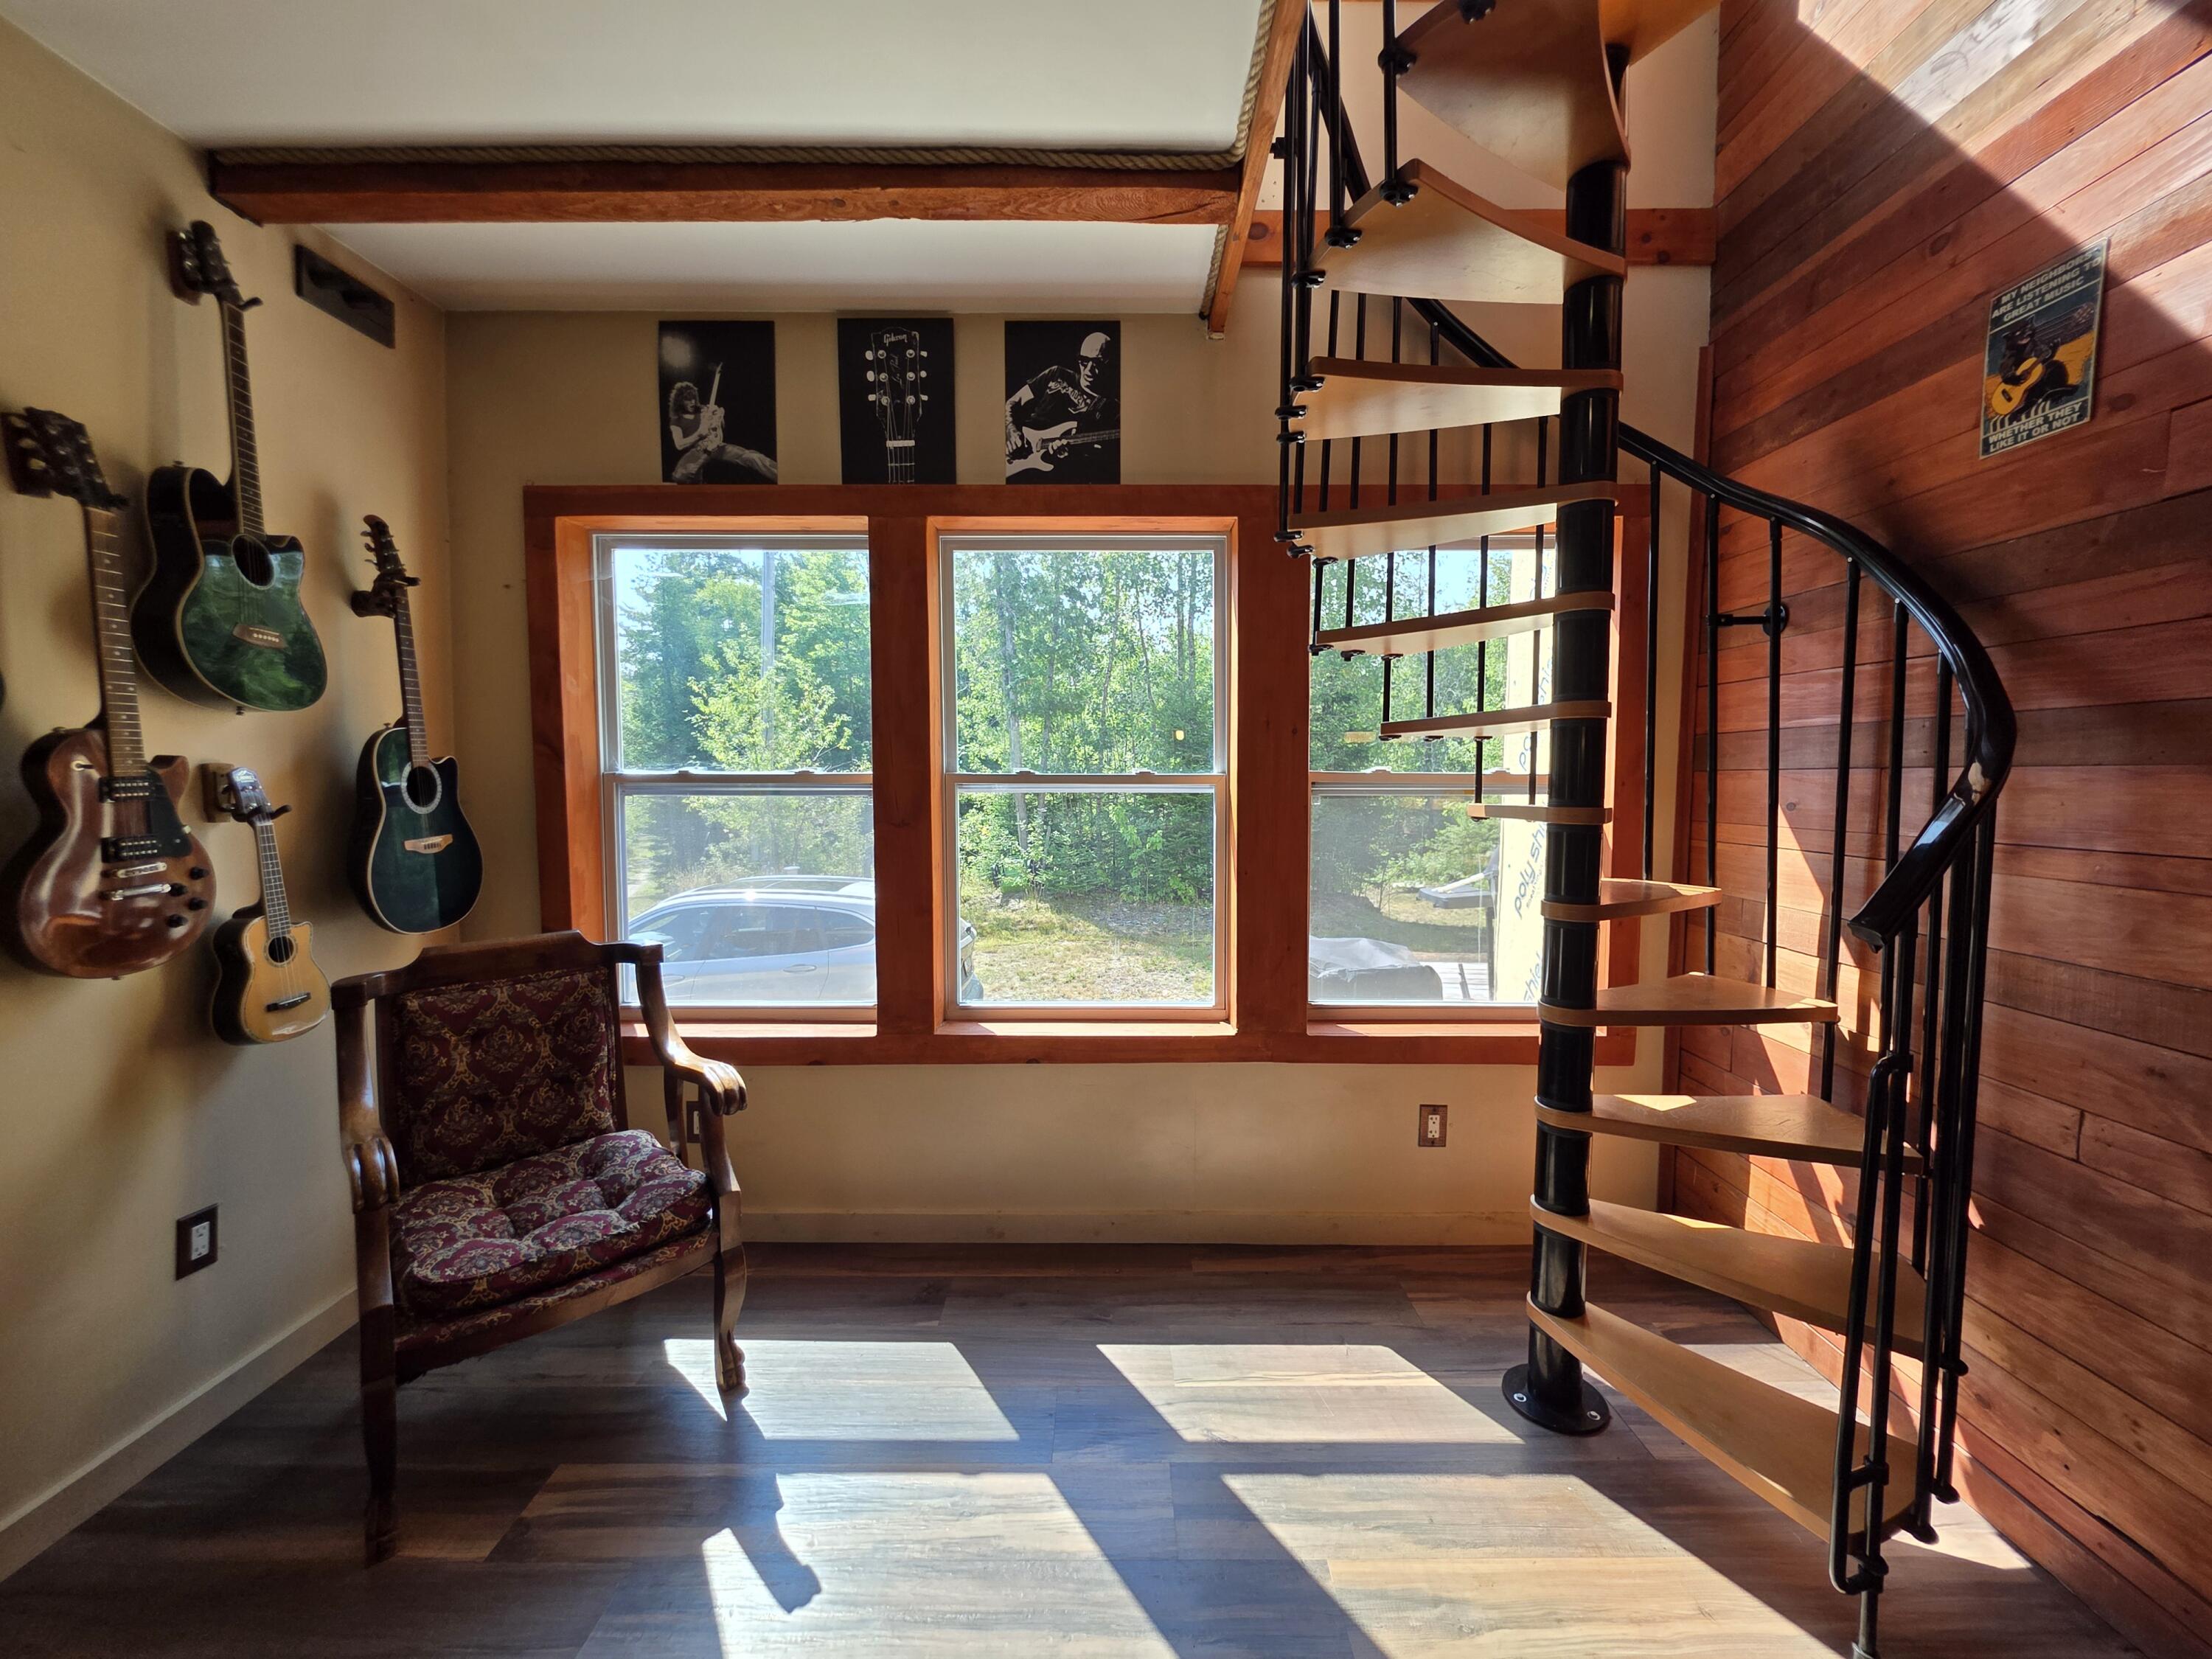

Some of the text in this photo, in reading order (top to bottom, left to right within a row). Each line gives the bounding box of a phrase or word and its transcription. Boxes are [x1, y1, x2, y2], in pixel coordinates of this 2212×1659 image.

[1992, 255, 2103, 319] ARE LISTENING TO
[2000, 251, 2093, 305] MY NEIGHBORS
[2003, 276, 2084, 321] GREAT MUSIC
[883, 333, 908, 347] Gibson
[1989, 402, 2082, 444] WHETHER THEY
[1989, 412, 2081, 453] LIKE IT OR NOT
